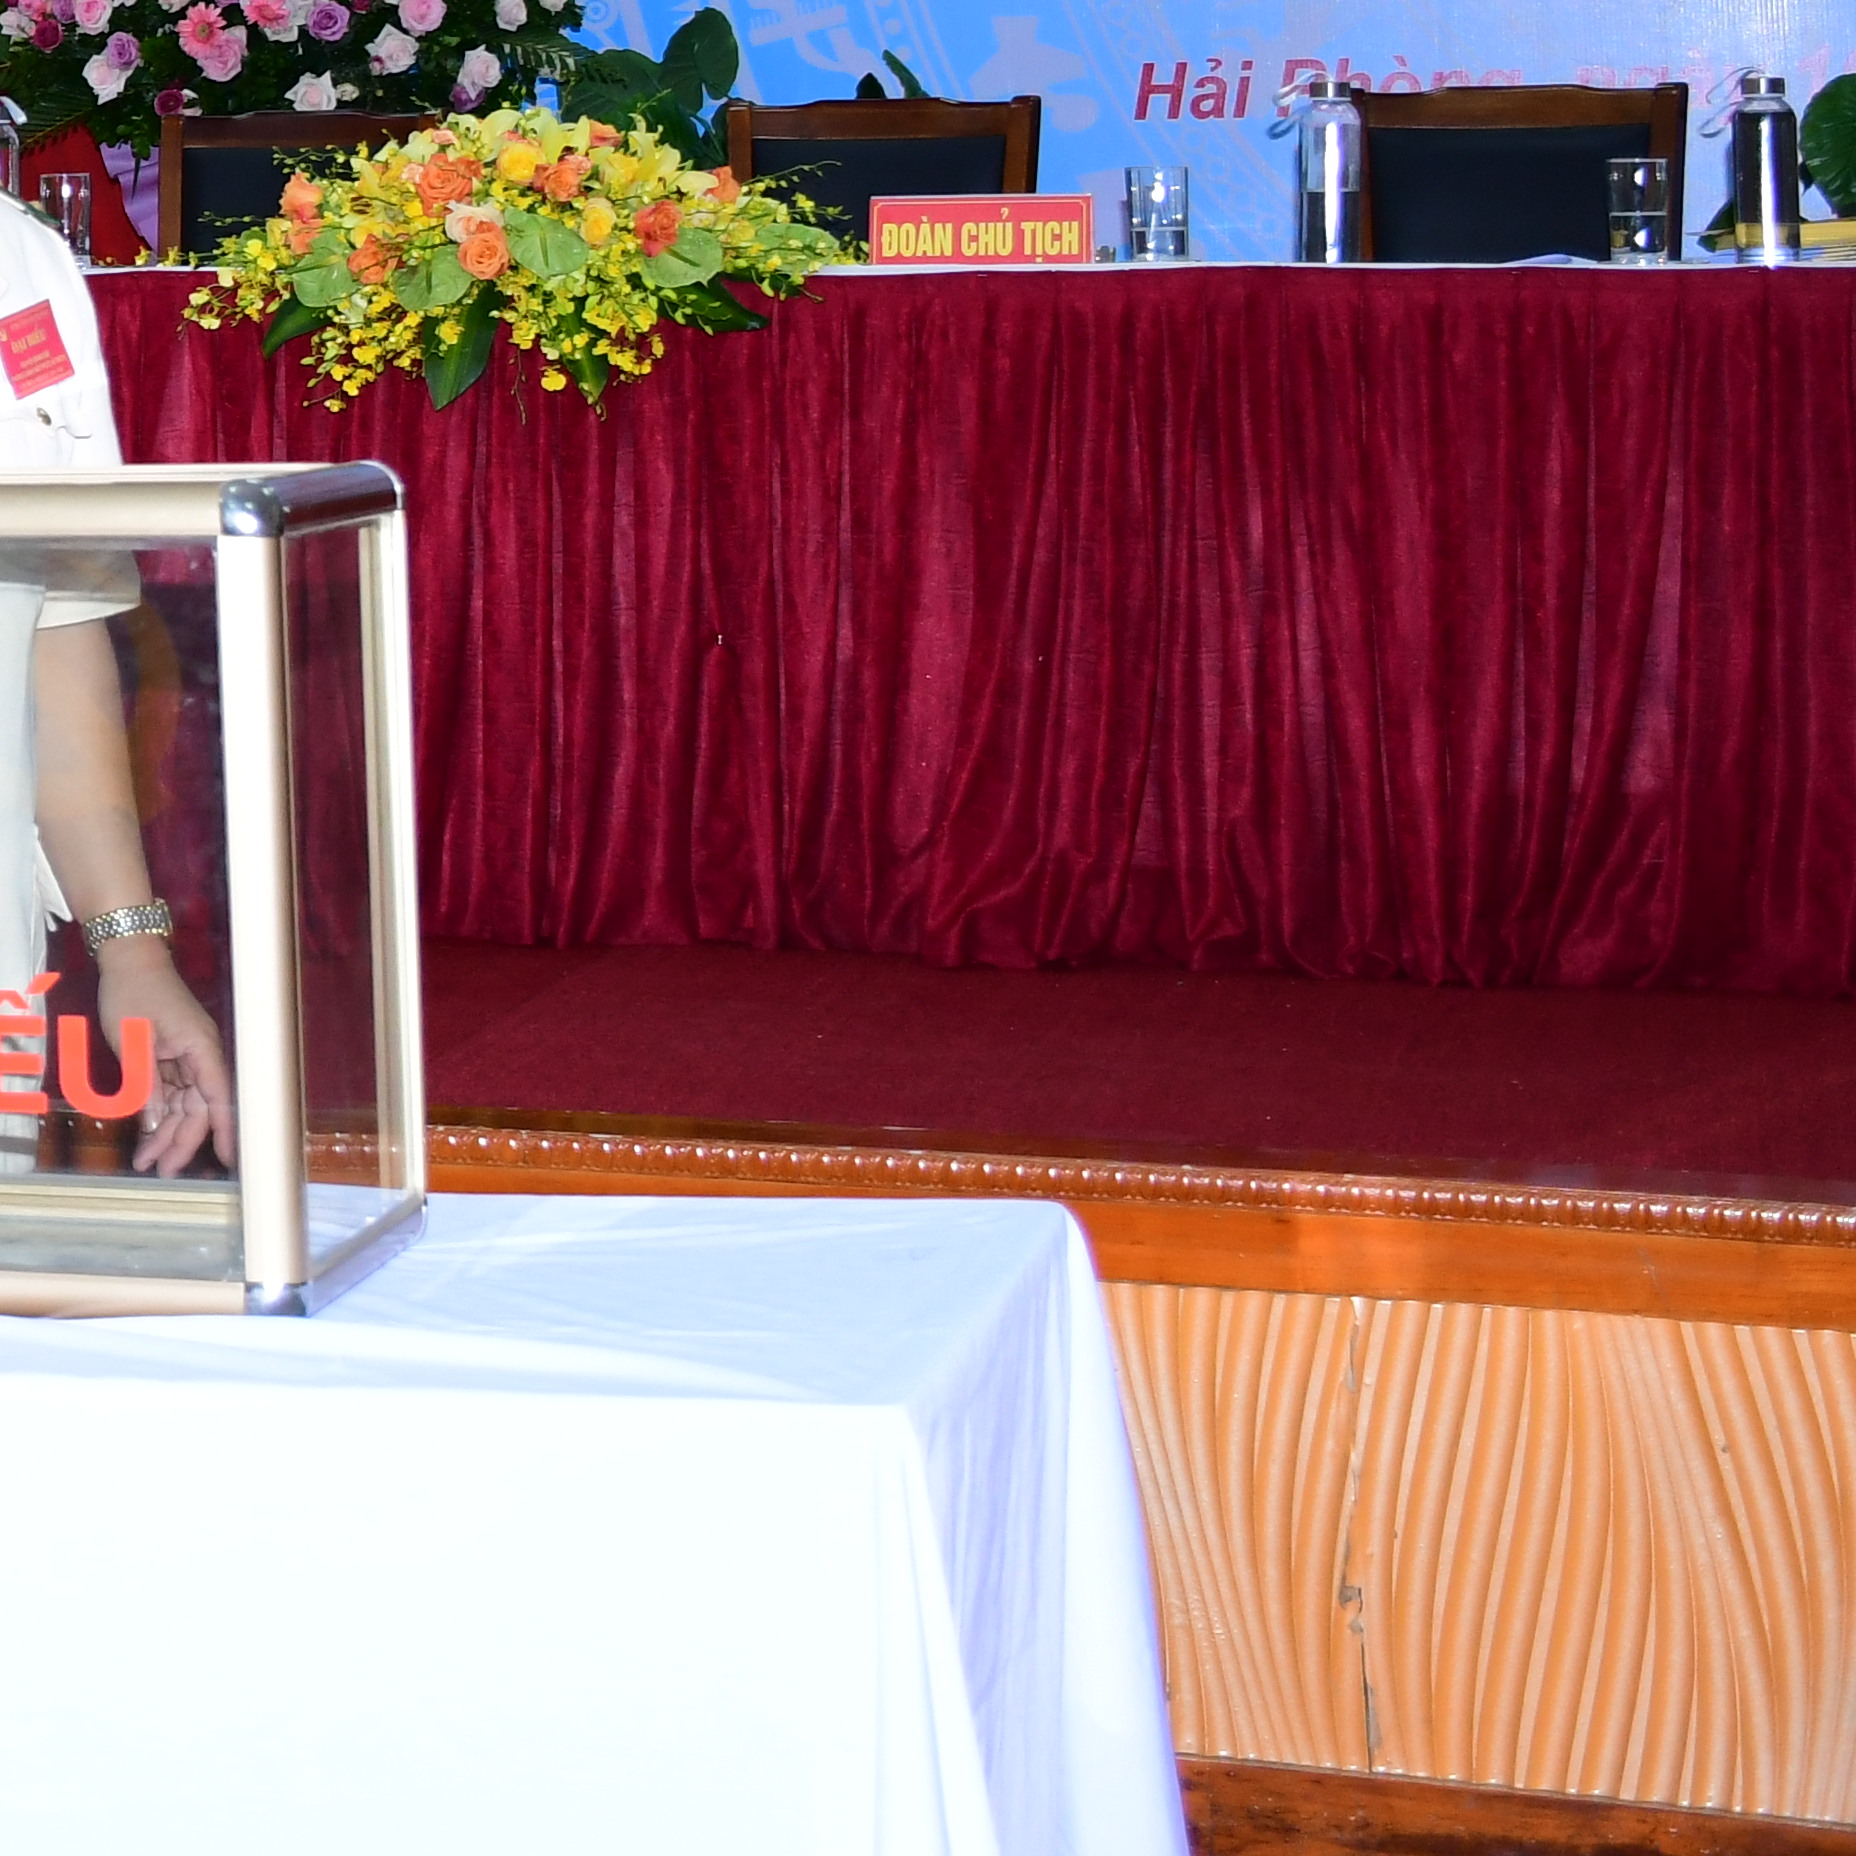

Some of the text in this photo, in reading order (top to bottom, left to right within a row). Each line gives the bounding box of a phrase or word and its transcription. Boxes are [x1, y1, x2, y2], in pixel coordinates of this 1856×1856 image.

[1133, 56, 1253, 121] Hải
[1276, 54, 1524, 119] Phò
[881, 207, 1079, 262] ĐOÀN CHỦ TỊCH
